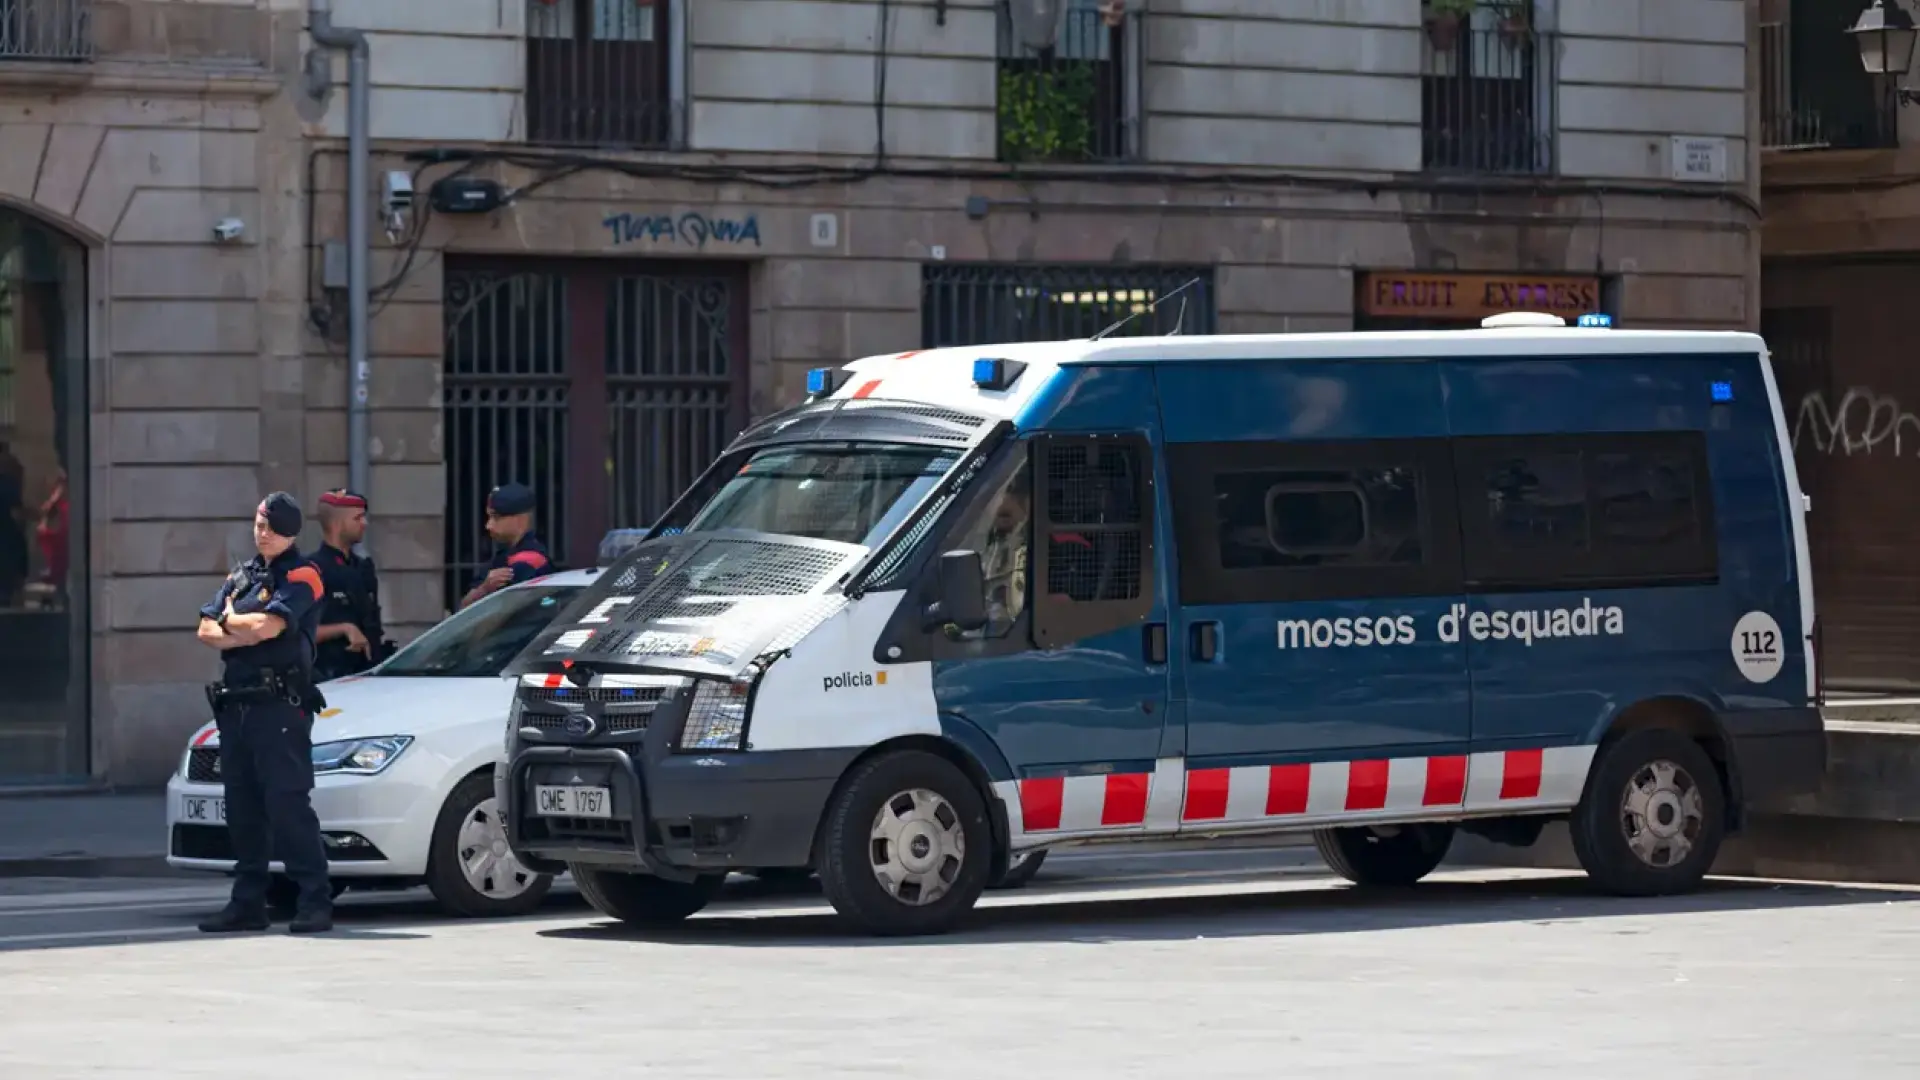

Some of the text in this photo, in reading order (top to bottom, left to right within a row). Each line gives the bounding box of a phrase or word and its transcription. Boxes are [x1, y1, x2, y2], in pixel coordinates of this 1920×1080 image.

[1374, 280, 1594, 309] FRUIT EXPRESS
[1278, 597, 1624, 650] mossos d'esquadra
[1741, 630, 1776, 654] 112
[823, 671, 873, 692] policia
[187, 799, 207, 820] CME
[541, 790, 603, 813] CME 1767
